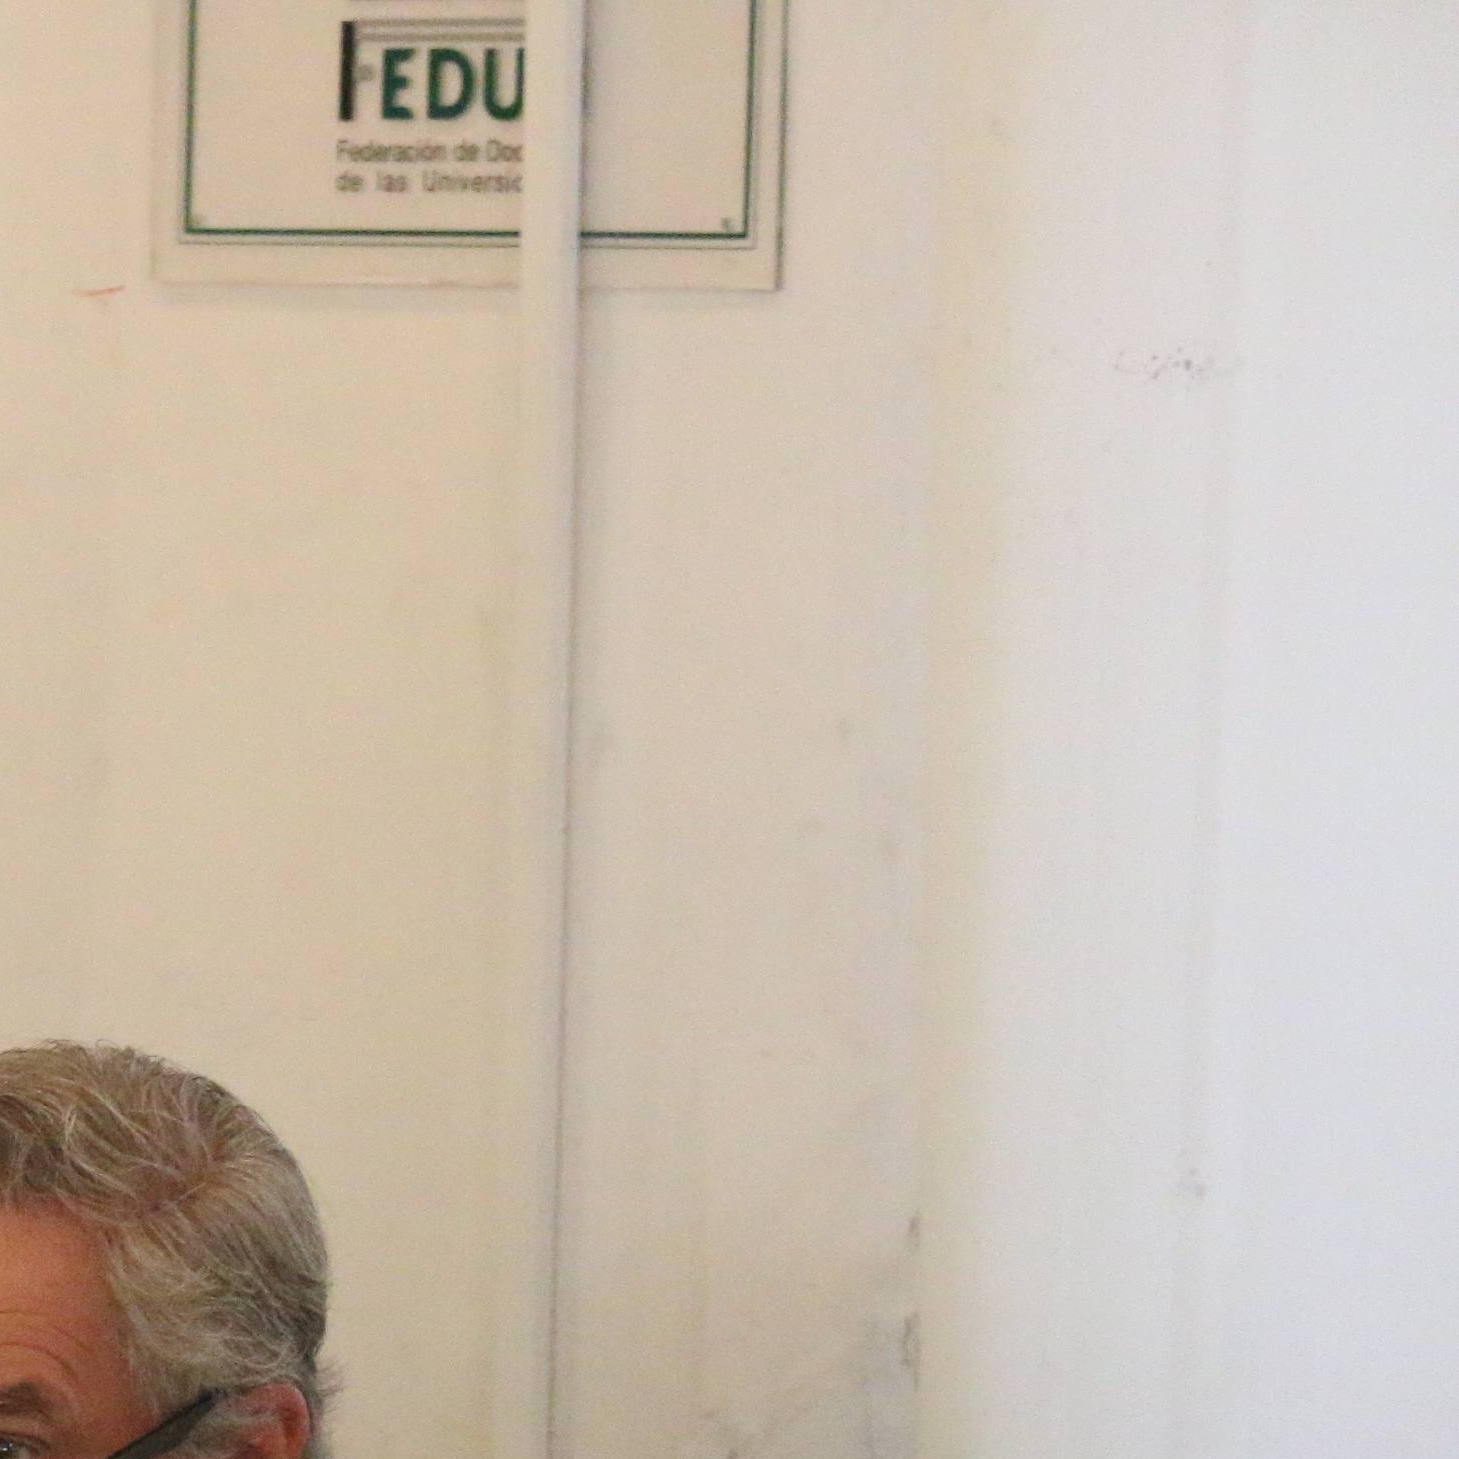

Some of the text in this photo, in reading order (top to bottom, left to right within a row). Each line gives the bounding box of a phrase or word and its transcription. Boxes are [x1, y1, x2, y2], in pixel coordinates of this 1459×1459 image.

[339, 20, 524, 122] FEDU
[454, 139, 479, 162] de
[486, 138, 523, 162] Doc
[335, 171, 363, 192] de
[377, 171, 408, 192] las
